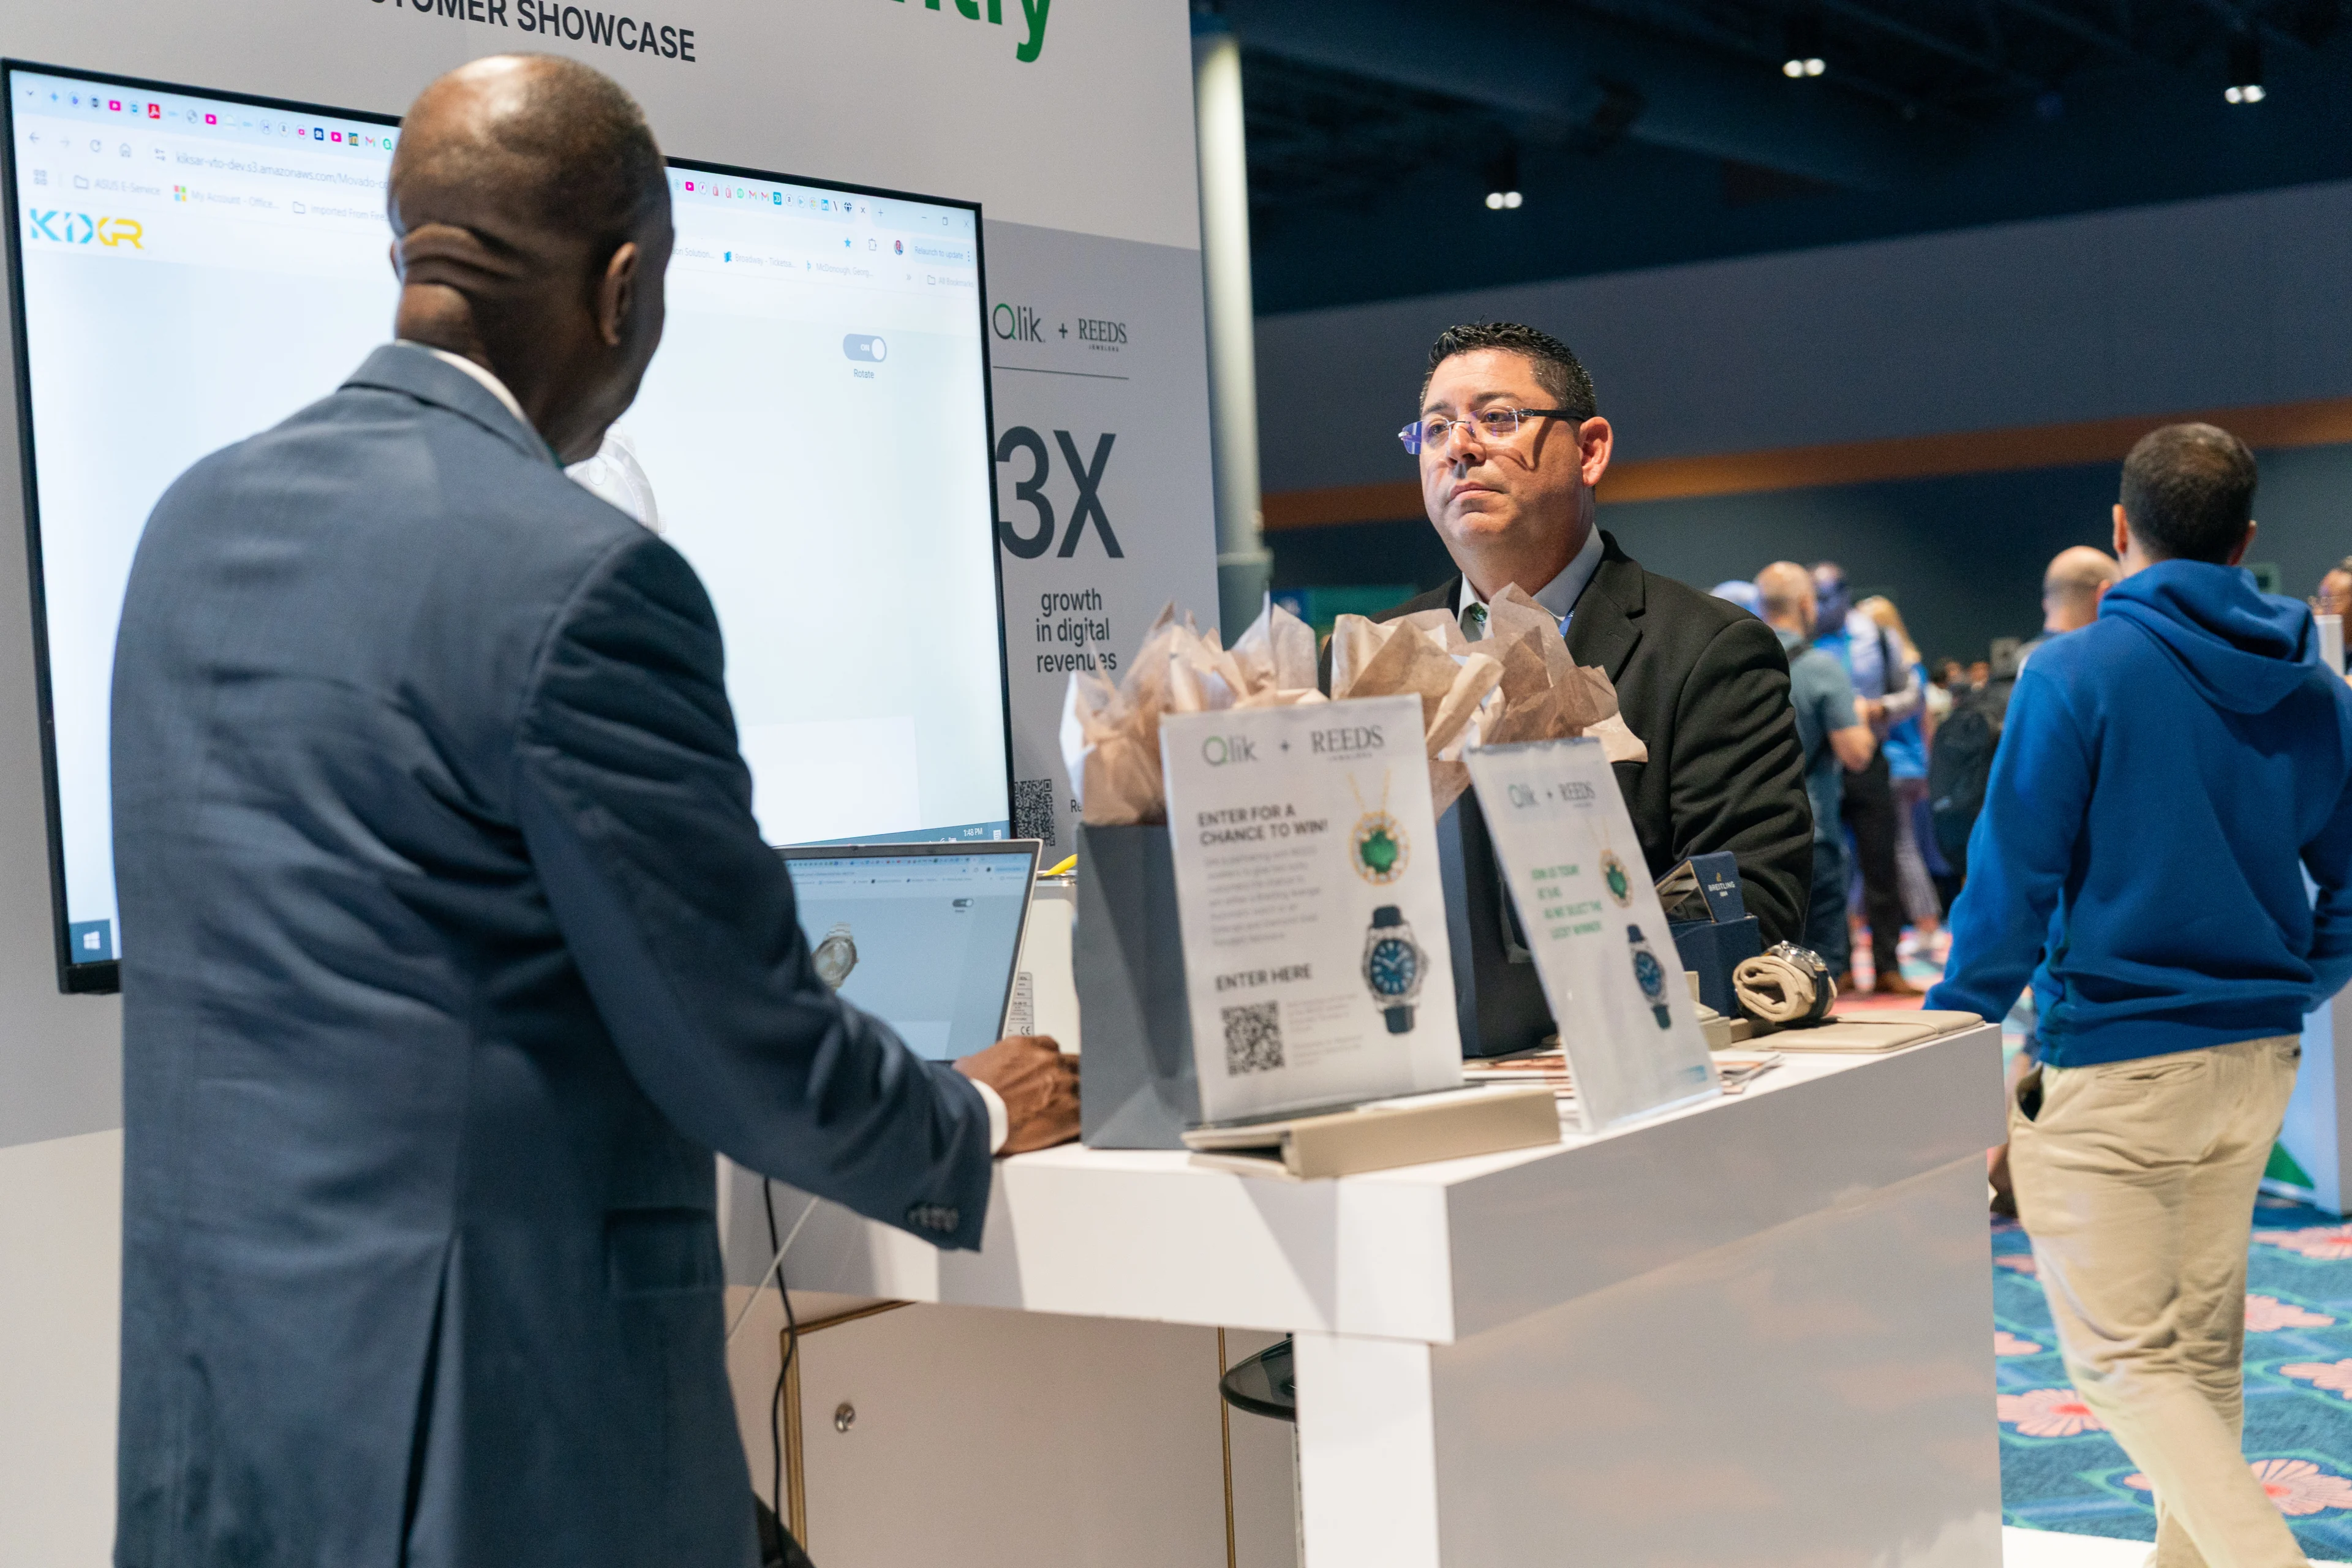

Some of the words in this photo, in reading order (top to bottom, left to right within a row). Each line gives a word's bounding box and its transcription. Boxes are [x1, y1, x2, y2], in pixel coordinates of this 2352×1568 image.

[517, 0, 696, 62] SHOWCASE
[914, 246, 938, 257] Relaunch
[992, 303, 1043, 343] Qlik
[1078, 318, 1128, 344] REEDS
[853, 368, 875, 379] Rotate
[996, 426, 1125, 559] 3X
[1041, 588, 1102, 617] growth
[1036, 618, 1052, 642] in
[1057, 617, 1110, 647] digital
[1036, 652, 1117, 673] revenues
[1311, 725, 1384, 754] REEDS
[1198, 809, 1248, 827] ENTER
[1250, 804, 1281, 821] FOR
[1286, 802, 1296, 817] A
[963, 828, 974, 837] 1:48
[1200, 826, 1265, 847] CHANCE
[1268, 823, 1291, 839] TO
[1708, 881, 1735, 892] BREITLING
[1215, 971, 1268, 993] ENTER
[1270, 963, 1312, 984] HERE
